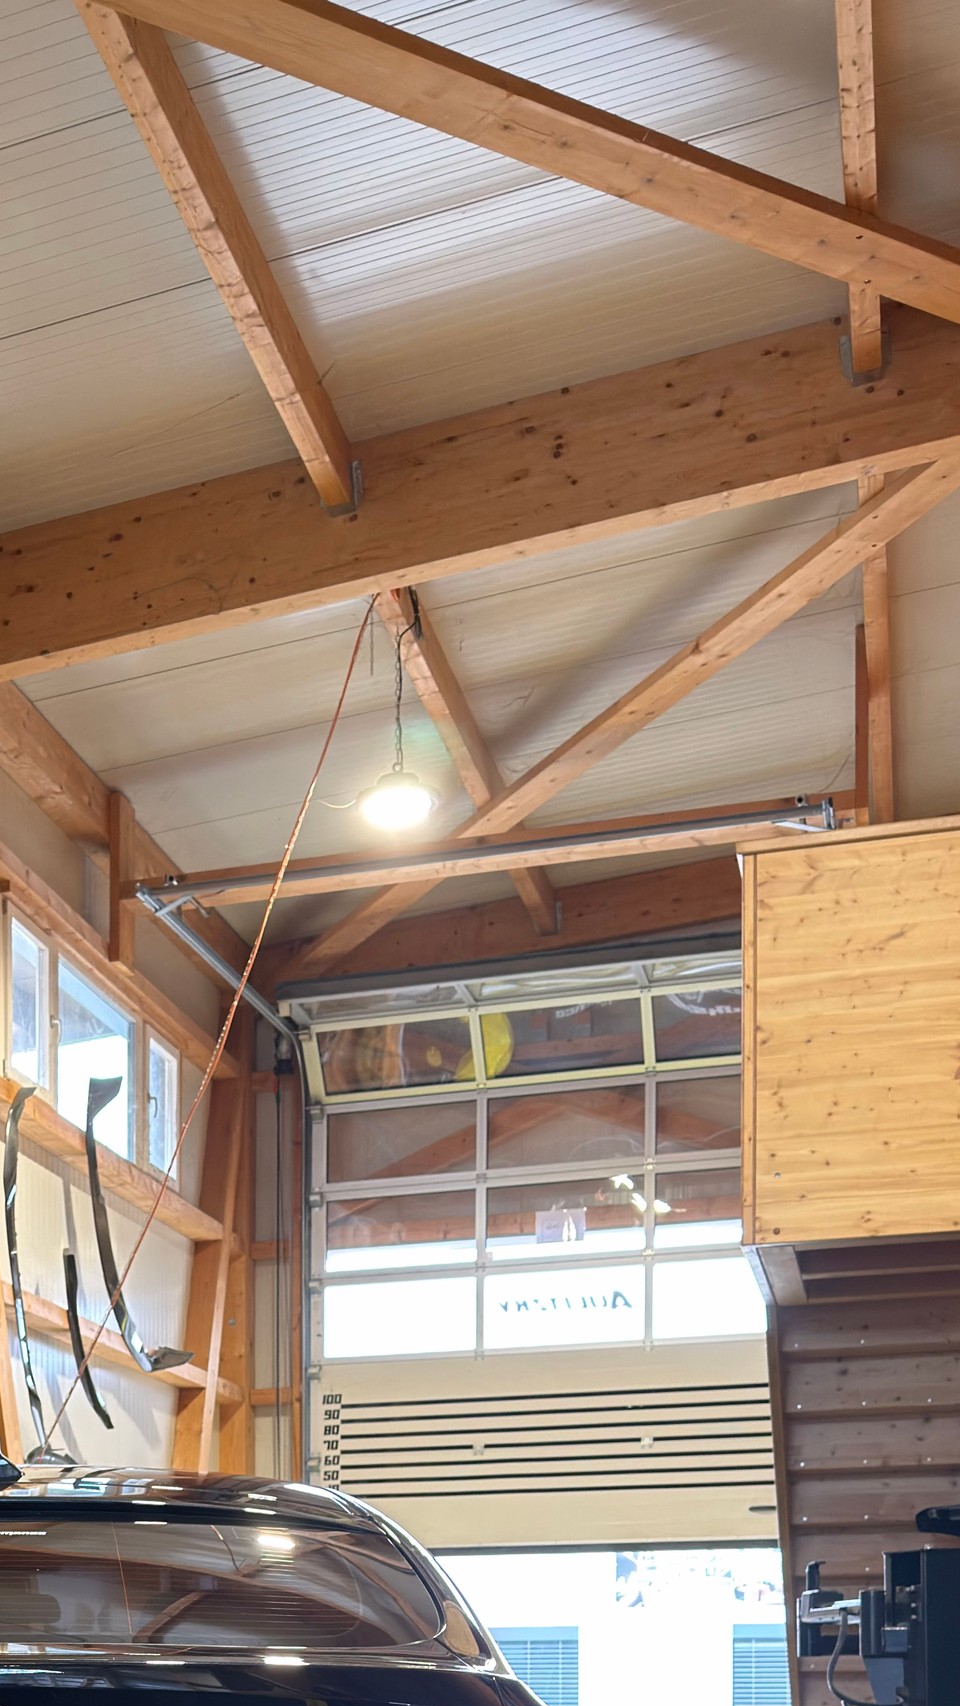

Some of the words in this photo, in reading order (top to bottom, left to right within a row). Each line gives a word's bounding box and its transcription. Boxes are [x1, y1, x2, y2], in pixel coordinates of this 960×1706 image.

[322, 1394, 342, 1405] 100
[324, 1410, 340, 1420] 90
[324, 1425, 340, 1435] 80
[323, 1440, 338, 1450] 70
[324, 1455, 340, 1466] 60
[323, 1470, 339, 1481] 50
